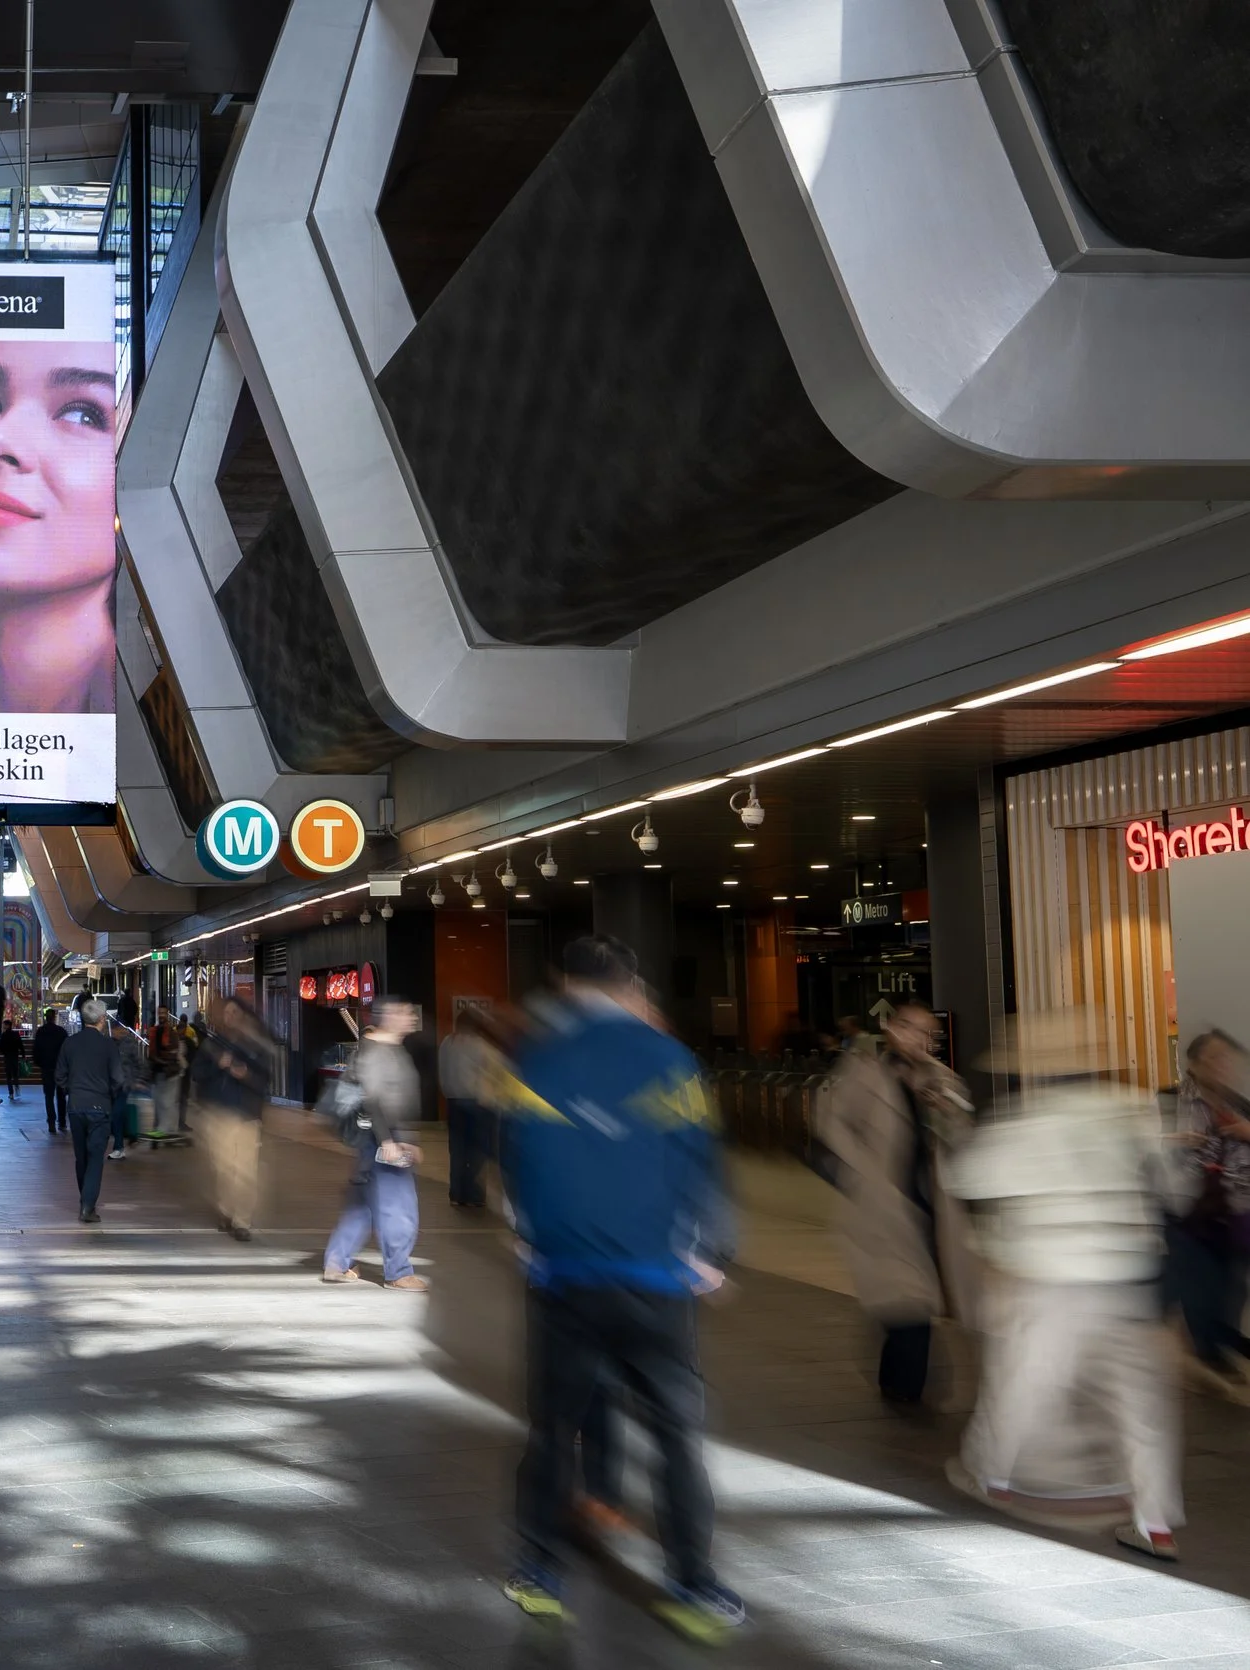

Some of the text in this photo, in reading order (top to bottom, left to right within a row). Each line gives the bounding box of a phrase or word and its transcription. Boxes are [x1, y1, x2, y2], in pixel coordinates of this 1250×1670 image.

[224, 816, 263, 856] M
[313, 818, 343, 858] T
[1126, 807, 1250, 873] Sharet
[864, 903, 888, 919] Metro
[877, 972, 917, 993] Lift
